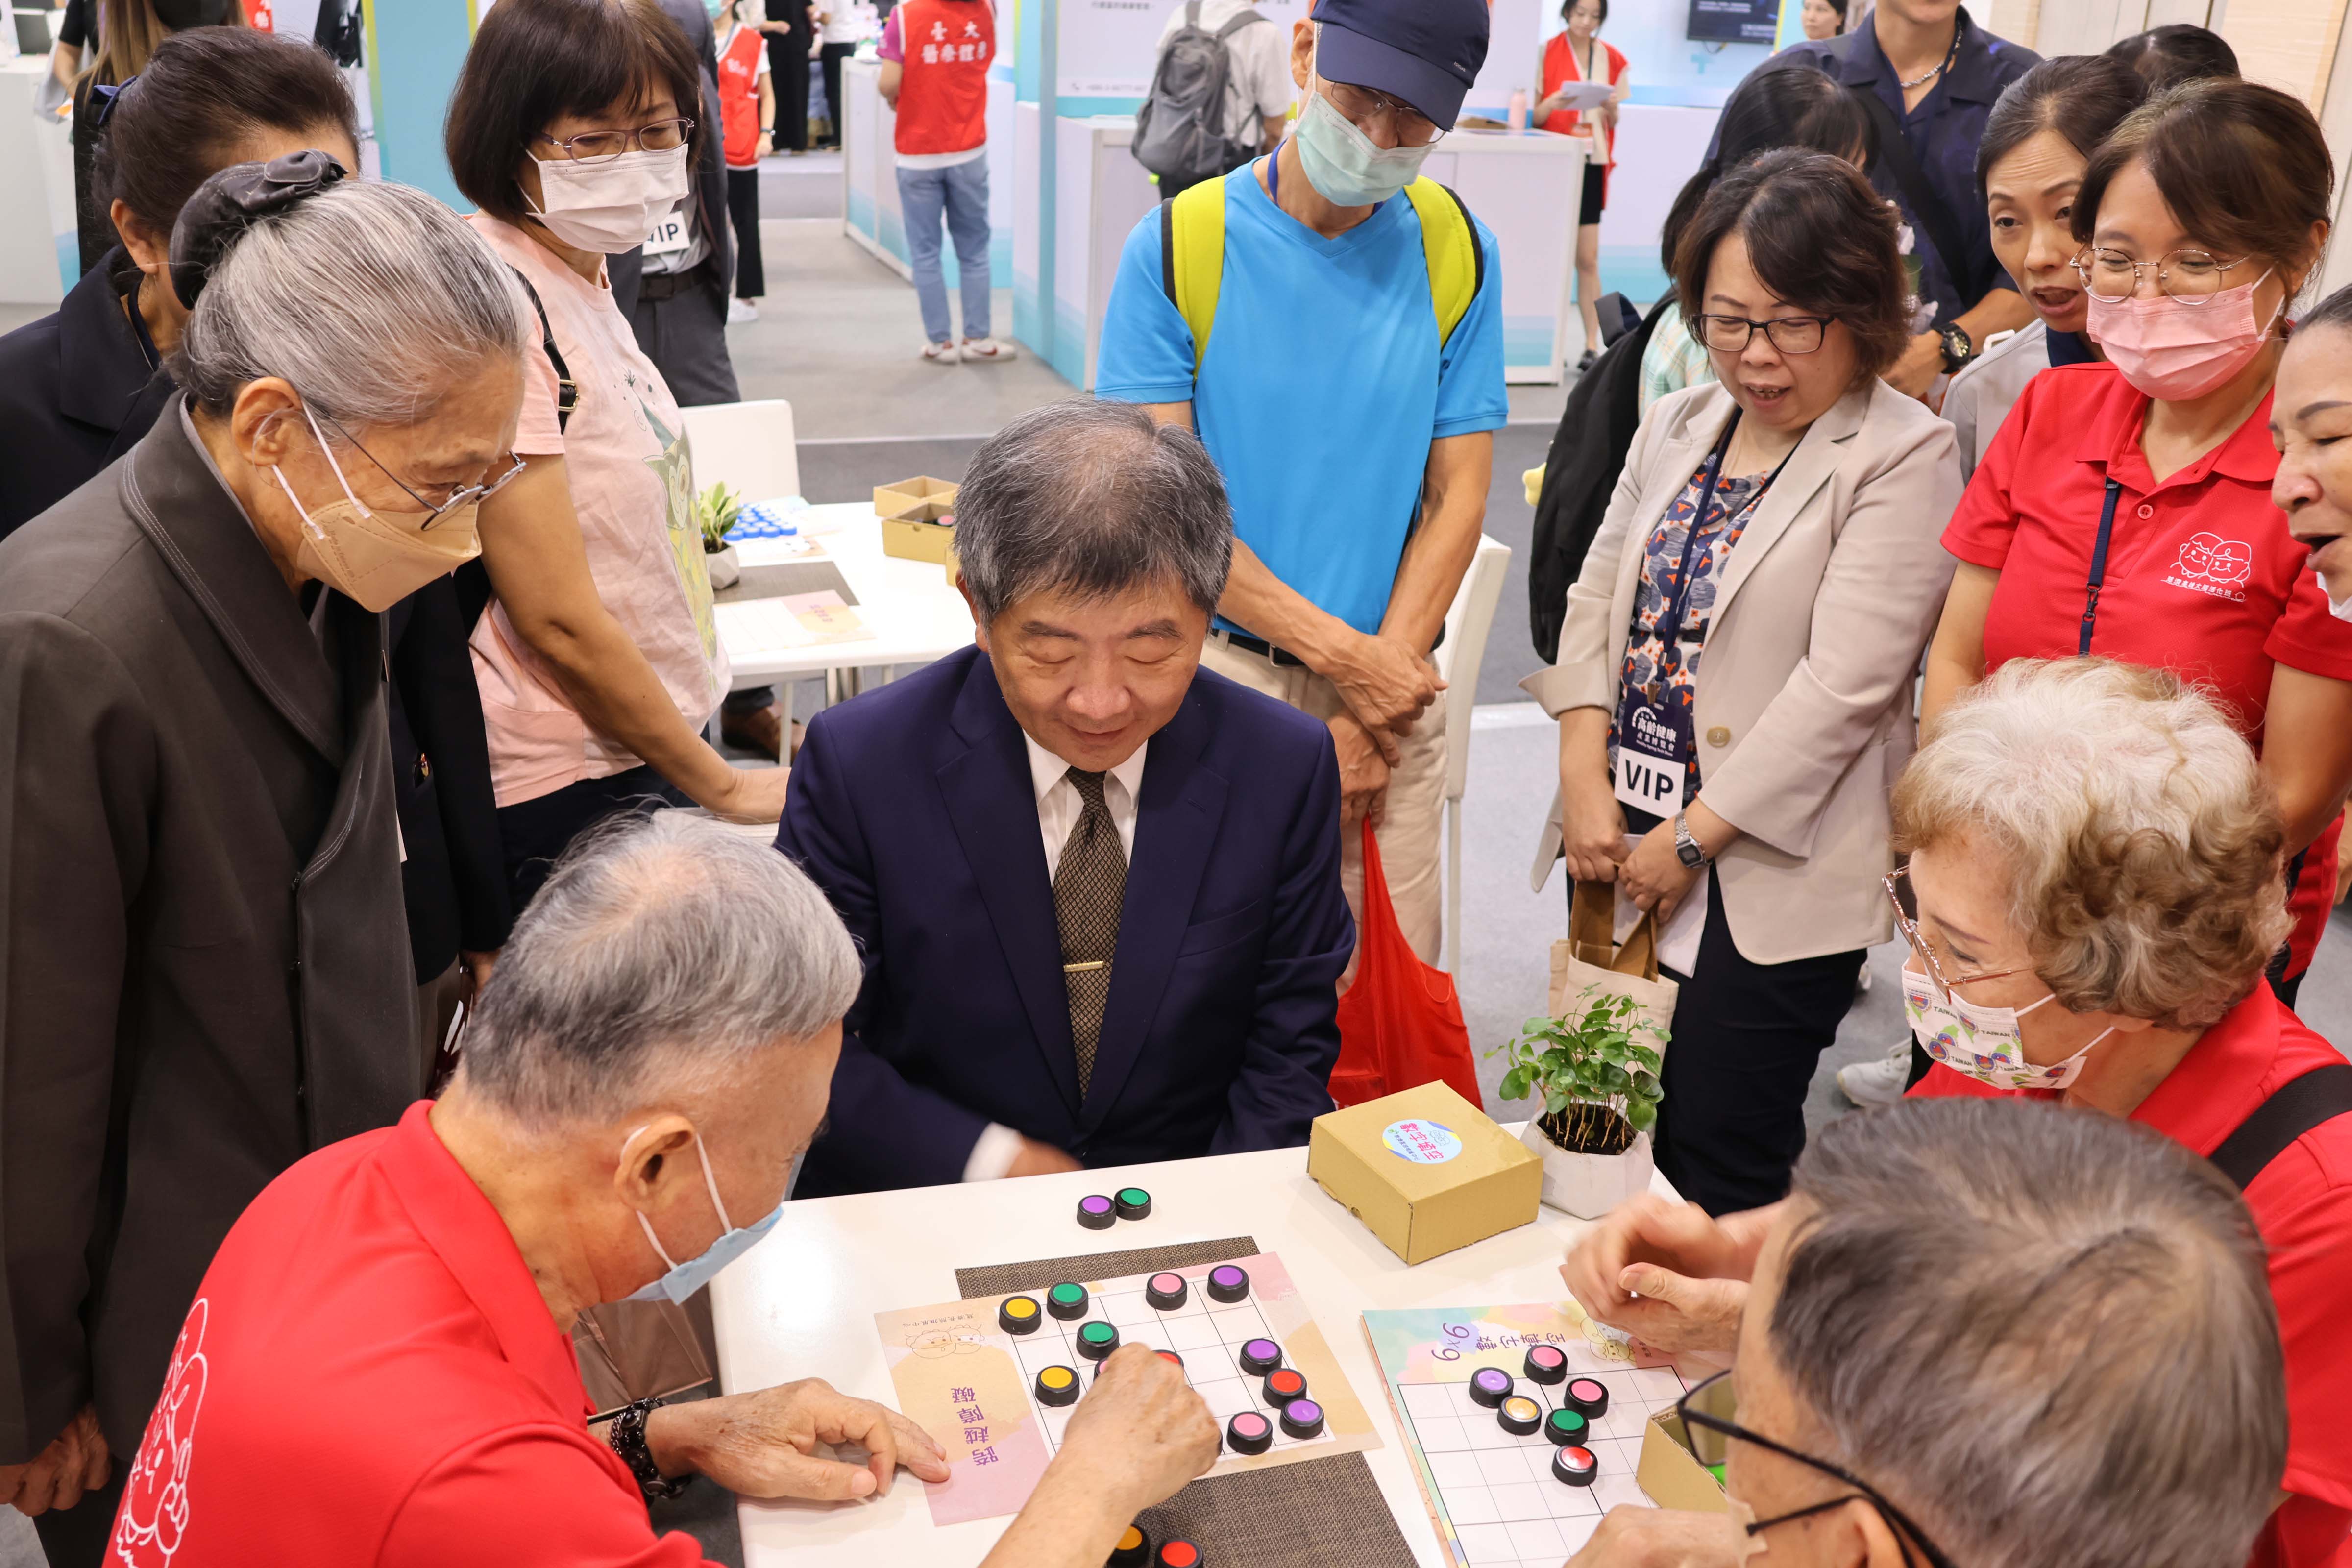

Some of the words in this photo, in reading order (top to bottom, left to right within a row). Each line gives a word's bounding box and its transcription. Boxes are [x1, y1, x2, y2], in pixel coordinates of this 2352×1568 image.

[1625, 759, 1674, 801] VIP
[1934, 1006, 1958, 1020] TAIWAN
[1951, 1056, 1973, 1067] TAIWAN
[1400, 1123, 1444, 1161] 數字填空
[1475, 1332, 1566, 1352] 數字填空
[950, 1386, 999, 1466] 跨越障礙
